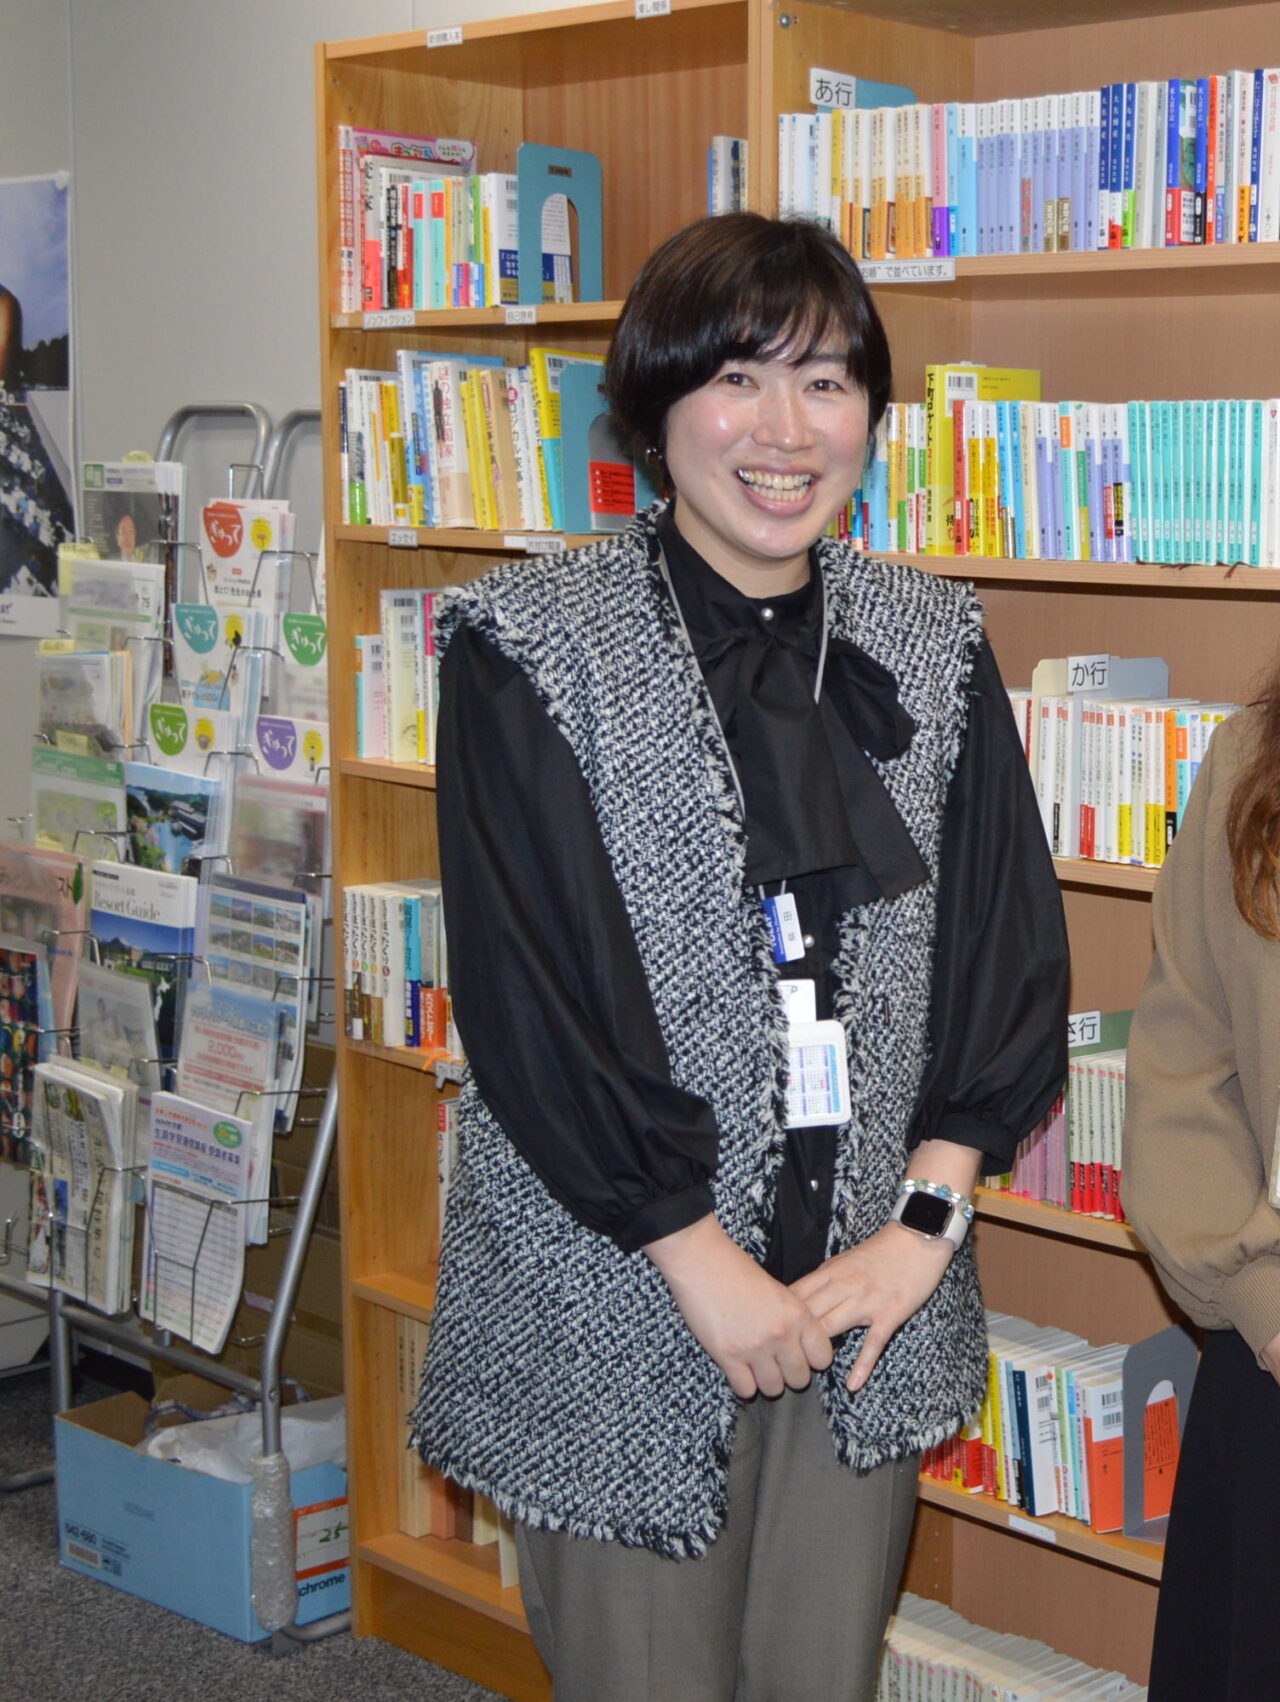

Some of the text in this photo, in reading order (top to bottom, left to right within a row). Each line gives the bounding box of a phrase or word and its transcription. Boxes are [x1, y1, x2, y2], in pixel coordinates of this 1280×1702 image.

[815, 78, 853, 107] あ行
[366, 314, 413, 327] ノンフィクション
[927, 372, 936, 446] 下町ロケット
[209, 519, 241, 546] ぎゅって
[391, 531, 415, 543] エッセイ
[184, 618, 217, 642] ぎゅって
[291, 628, 325, 653] ぎゅって
[1072, 661, 1107, 688] か行
[156, 718, 187, 742] ぎゅって
[263, 730, 295, 755] ぎゅって
[95, 890, 161, 921] Resort Guide
[298, 1572, 346, 1598] chrome
